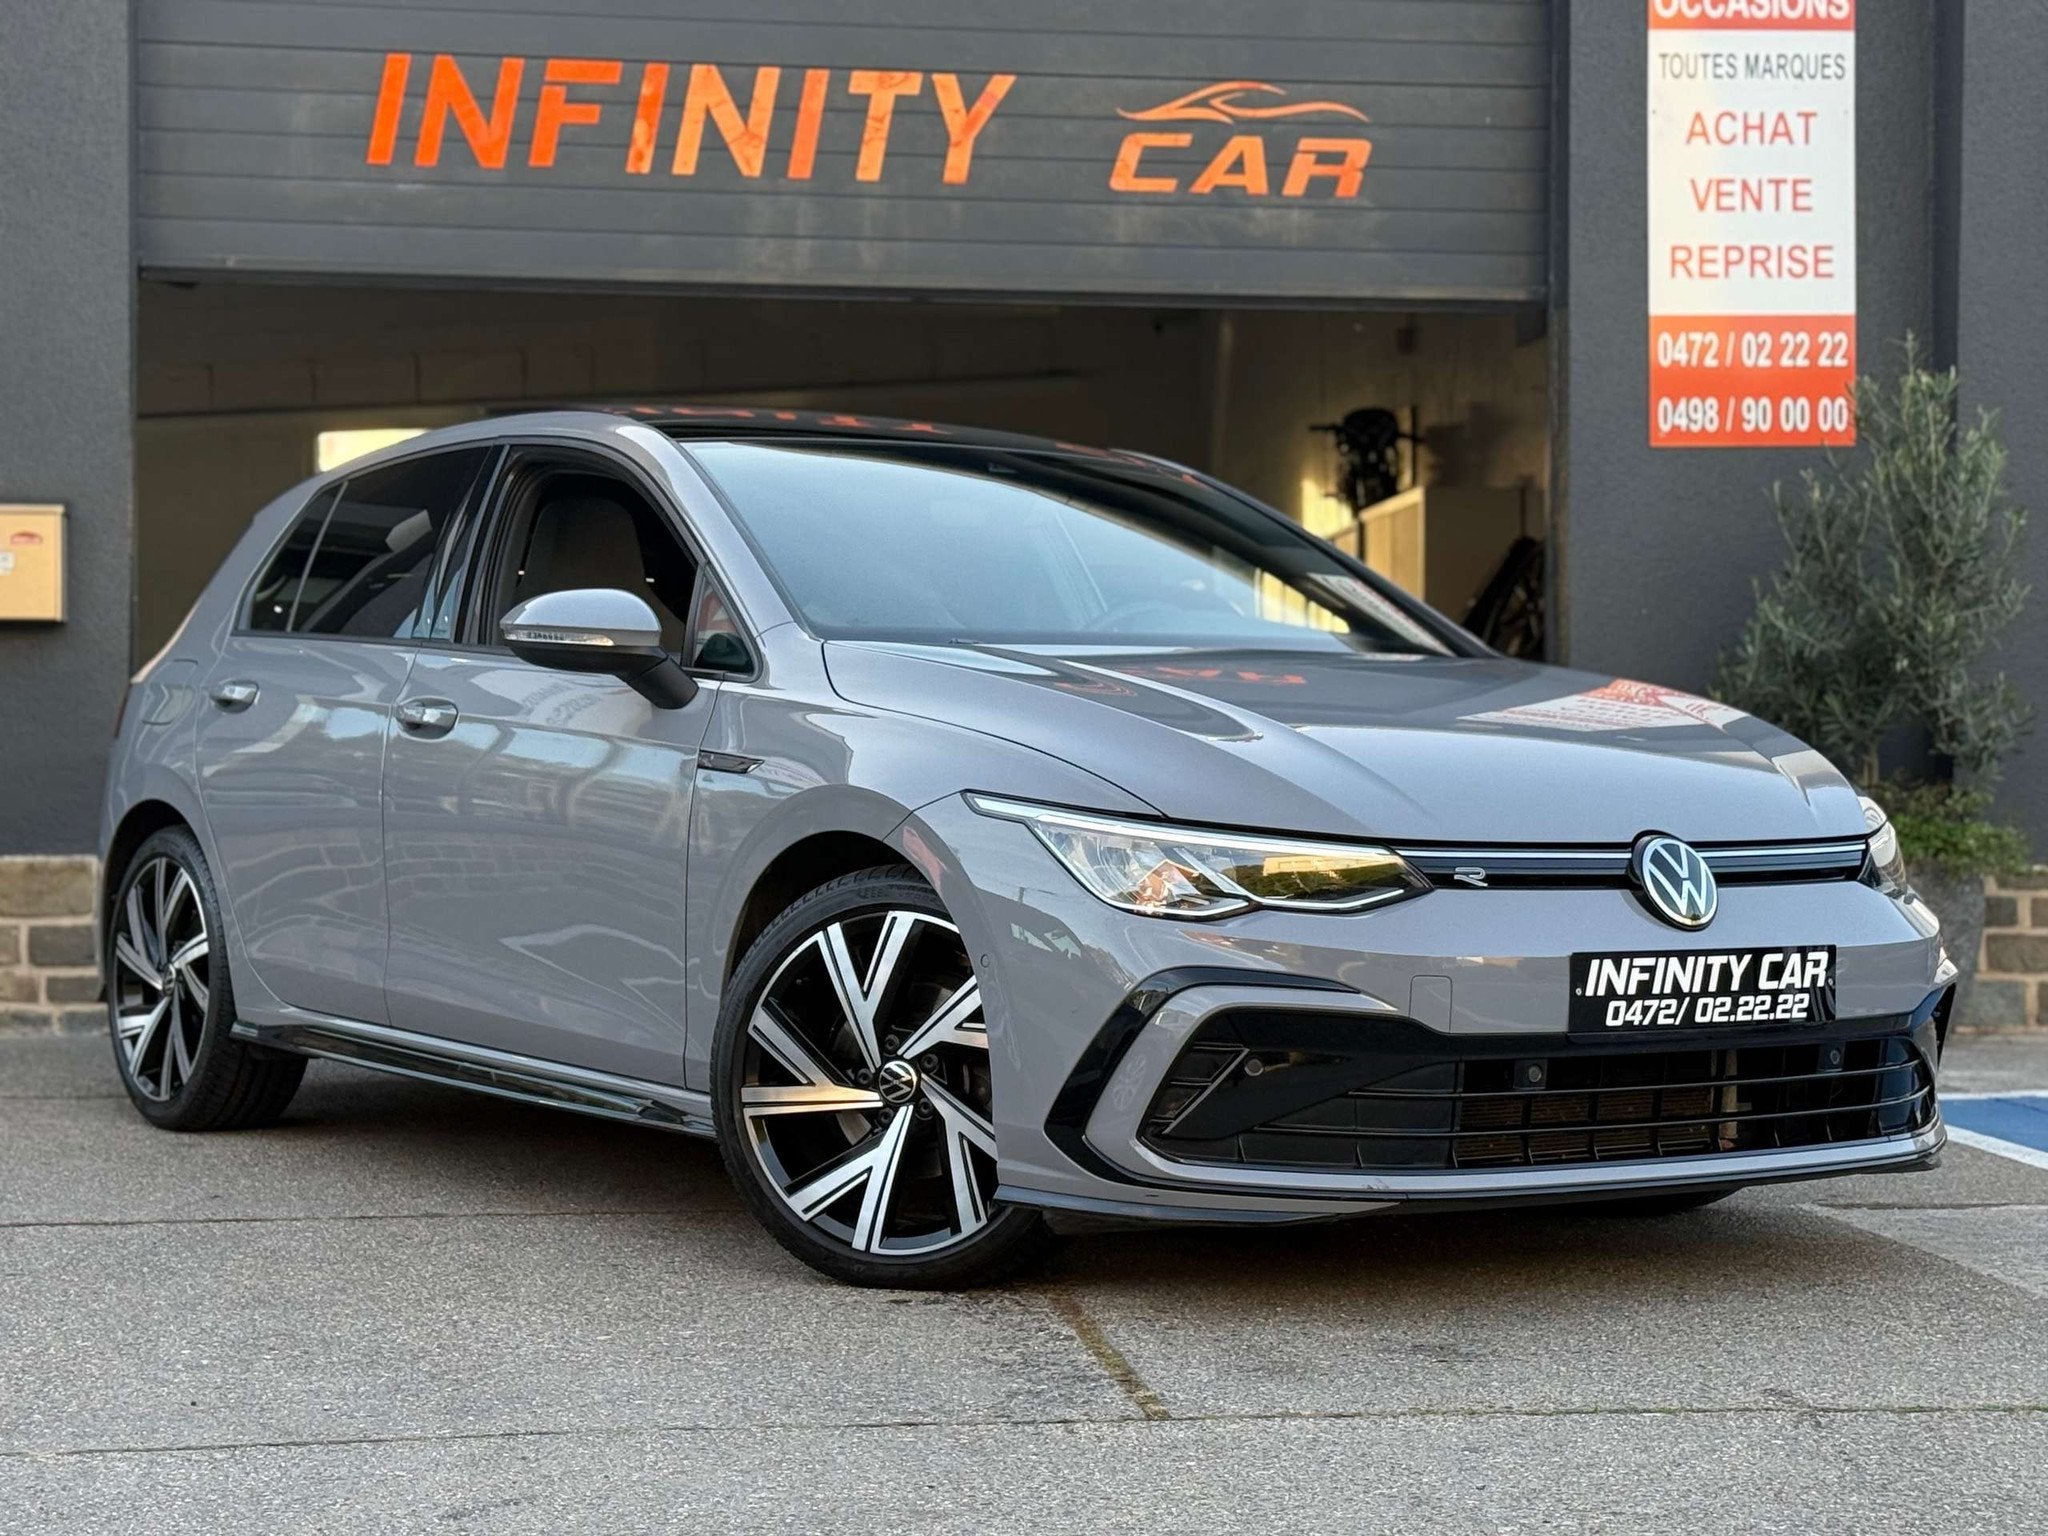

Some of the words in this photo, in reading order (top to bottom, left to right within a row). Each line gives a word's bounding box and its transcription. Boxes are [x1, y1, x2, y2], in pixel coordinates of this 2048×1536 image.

[1659, 53, 1737, 80] TOUTES
[1745, 53, 1846, 81] MARQUES
[366, 53, 1017, 184] INFINITY
[1109, 132, 1372, 197] CAR
[1686, 112, 1817, 145] ACHAT
[1690, 179, 1813, 212] VENTE
[1670, 245, 1834, 279] REPRISE
[1657, 331, 1719, 368] 0472
[1741, 331, 1773, 368] 02
[1779, 331, 1810, 368] 22
[1817, 331, 1849, 368] 22
[1657, 396, 1719, 433] 0498
[1741, 396, 1773, 433] 90
[1779, 396, 1810, 433] 00
[1817, 396, 1849, 433] 00
[1642, 835, 1719, 927] VW
[1584, 954, 1752, 997] INFINITY
[1758, 951, 1829, 990] CAR
[1605, 997, 1690, 1027] 0472/
[1694, 993, 1810, 1023] 02.22.22
